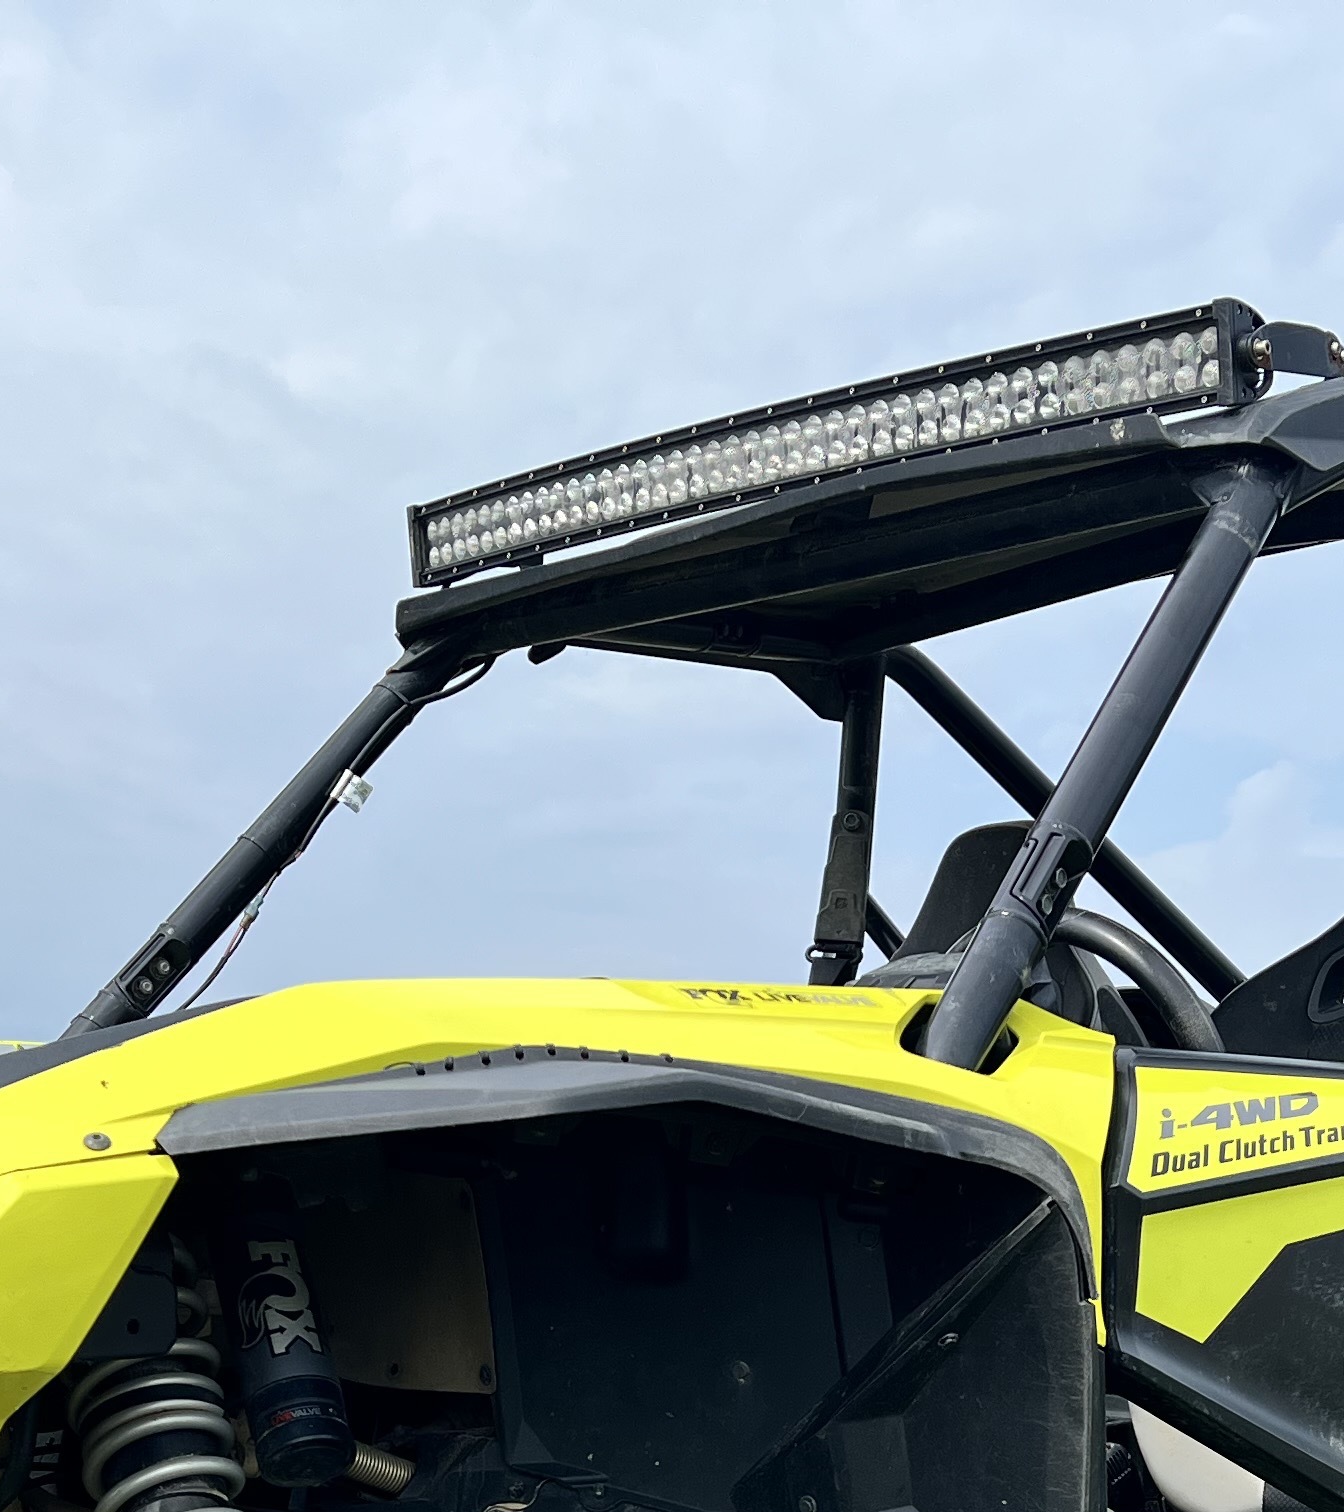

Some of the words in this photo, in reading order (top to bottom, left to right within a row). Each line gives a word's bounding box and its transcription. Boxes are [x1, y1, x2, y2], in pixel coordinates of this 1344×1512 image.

[1159, 1092, 1319, 1140] i-4WD
[1151, 1144, 1209, 1177] Dual
[1219, 1131, 1295, 1163] Clutch
[239, 1239, 323, 1355] FOX
